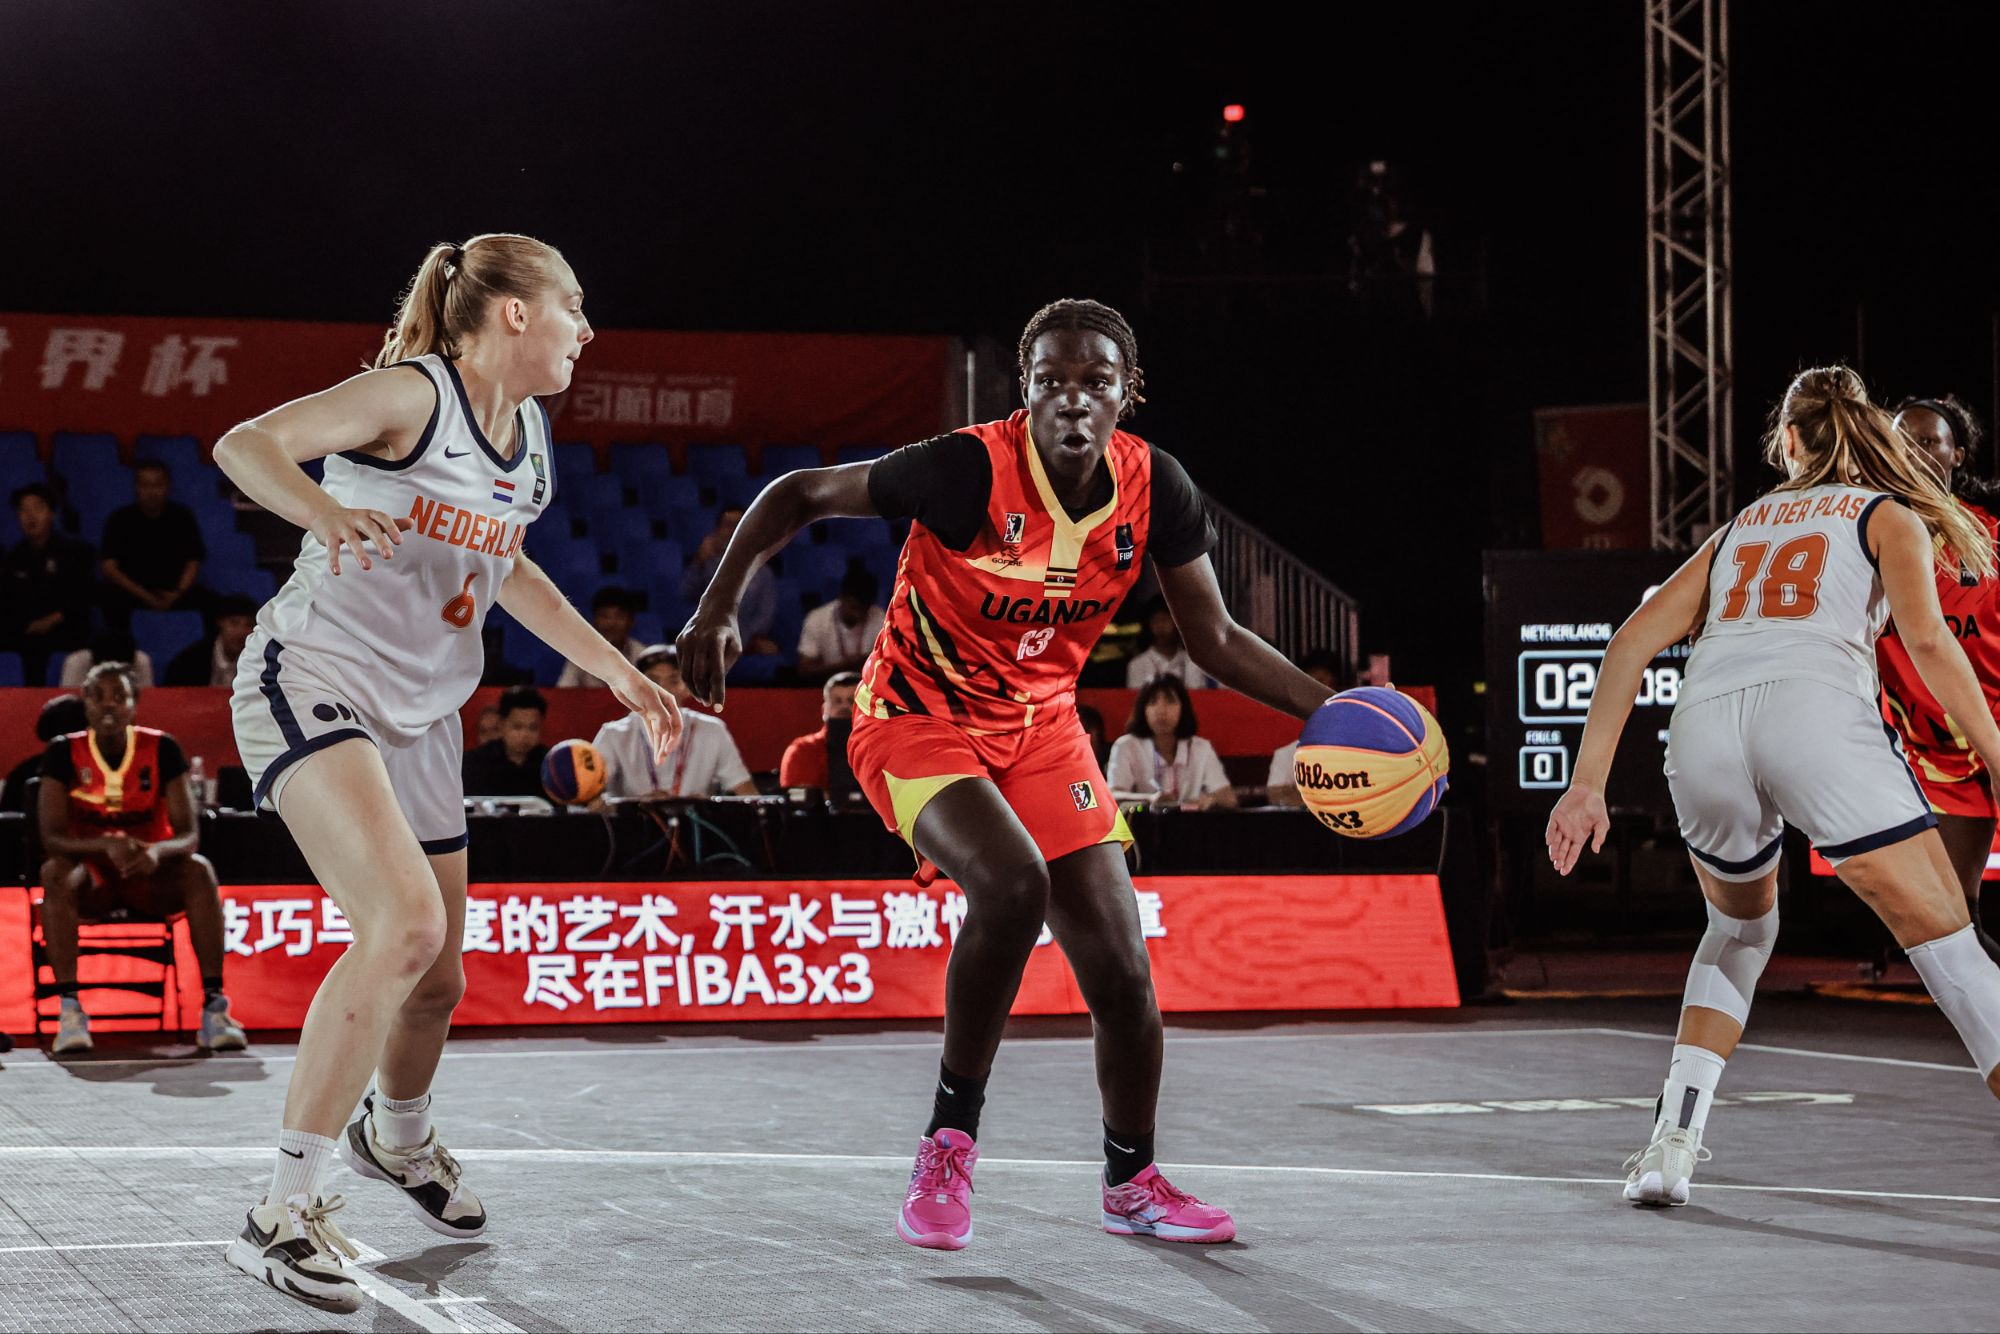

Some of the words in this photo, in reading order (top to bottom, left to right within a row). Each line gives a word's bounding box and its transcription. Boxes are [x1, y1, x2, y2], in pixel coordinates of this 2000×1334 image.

[0, 326, 240, 397] 界杯
[1772, 499, 1812, 526] DER
[1811, 494, 1866, 520] PLAS
[440, 572, 480, 628] 6
[1718, 532, 1829, 622] 18
[1535, 662, 1597, 710] 02
[1294, 761, 1372, 790] Wilson
[1533, 752, 1554, 781] 0
[524, 953, 874, 1011] 尽在FIBA3x3
